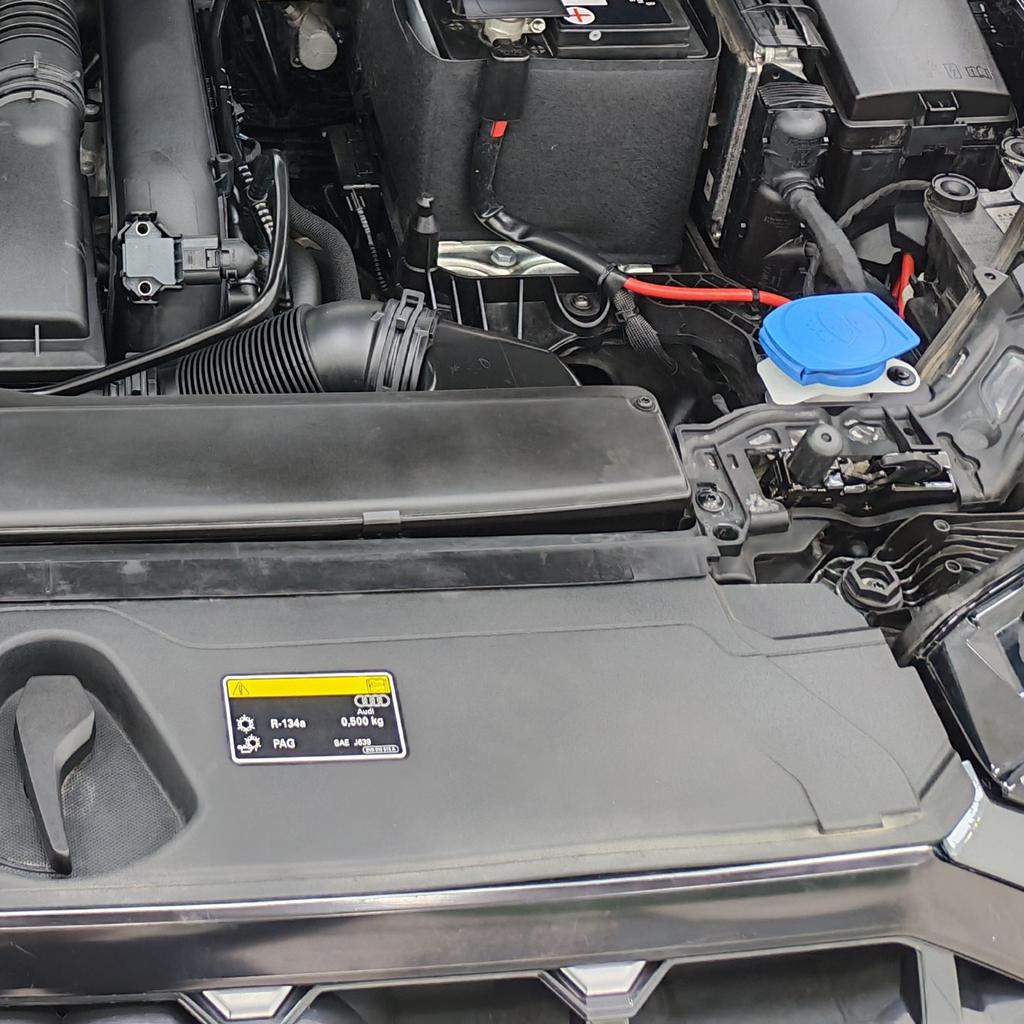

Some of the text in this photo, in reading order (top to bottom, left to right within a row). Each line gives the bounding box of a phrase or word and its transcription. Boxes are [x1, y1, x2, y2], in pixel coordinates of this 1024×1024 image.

[270, 718, 307, 729] R-134a
[340, 717, 385, 728] 0,500 kg
[273, 738, 296, 749] PAG
[333, 739, 350, 748] SAE
